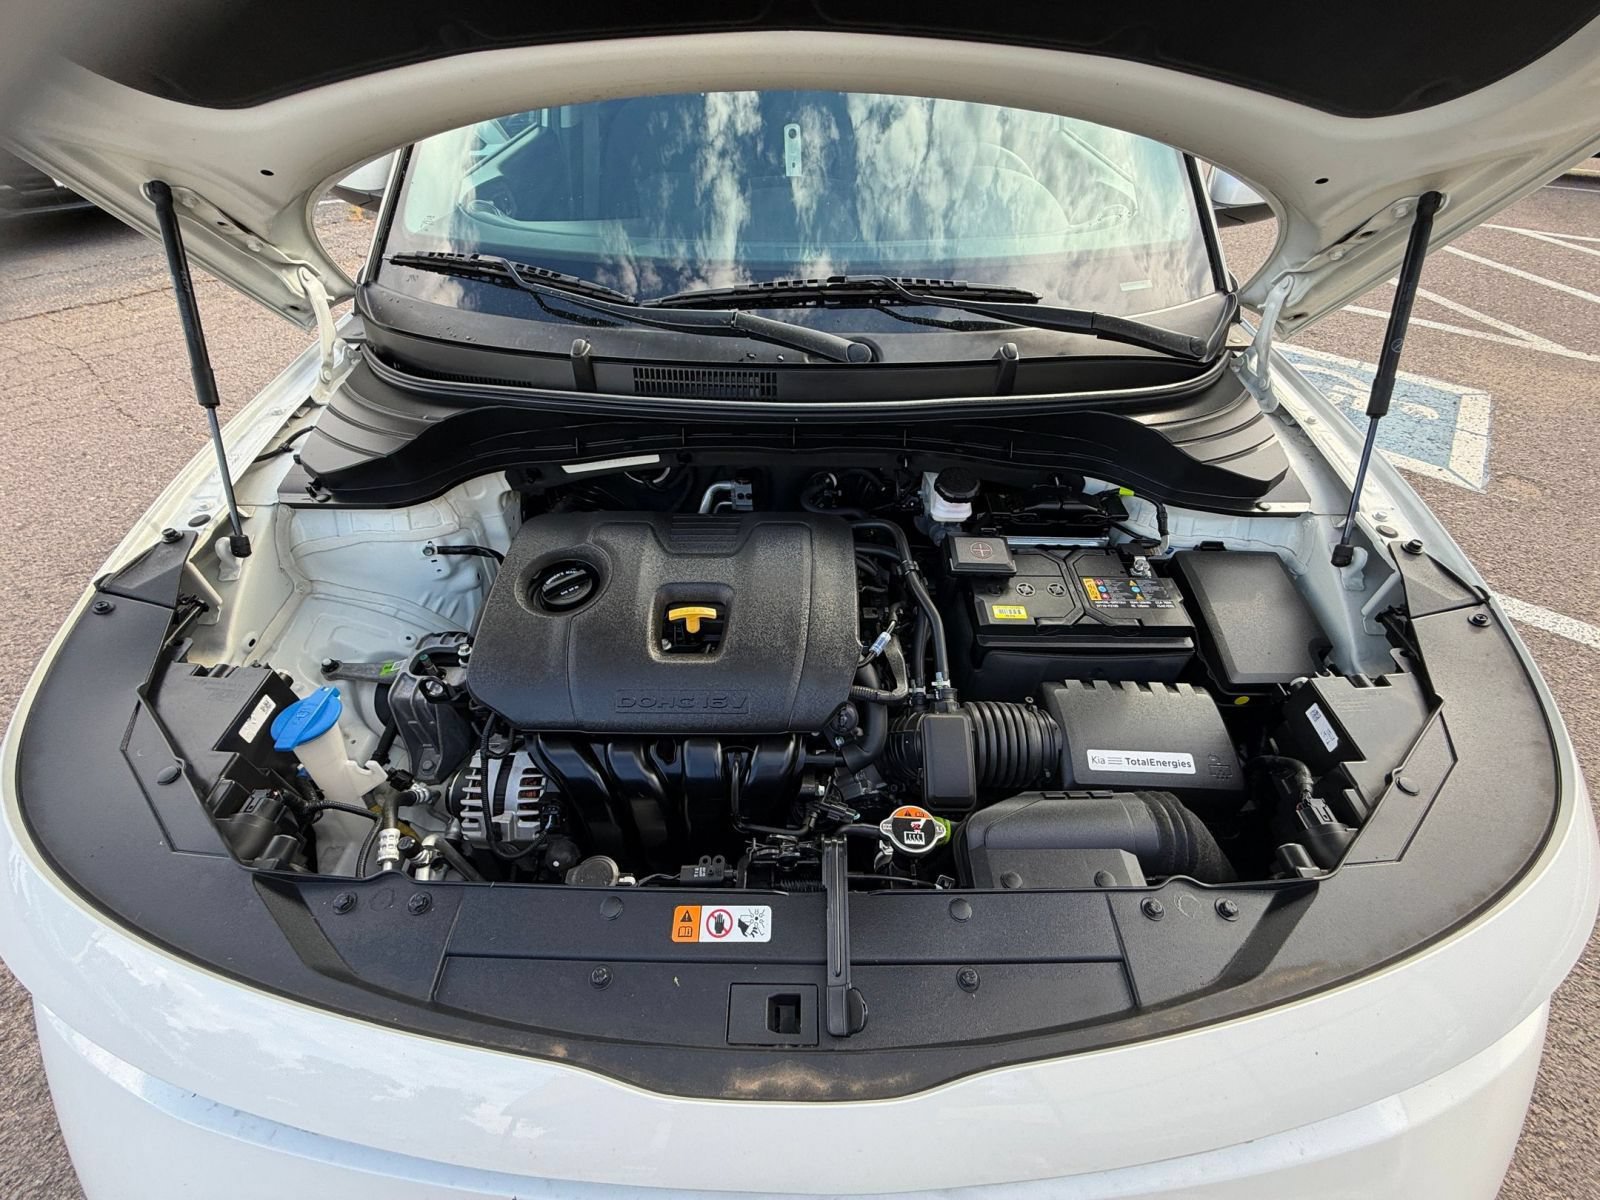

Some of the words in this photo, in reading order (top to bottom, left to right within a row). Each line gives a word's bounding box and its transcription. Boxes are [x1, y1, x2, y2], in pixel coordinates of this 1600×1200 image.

[617, 695, 695, 708] DOHC
[703, 695, 748, 709] 16V
[1091, 755, 1106, 765] Kia
[1124, 756, 1192, 769] TotalEnergies
